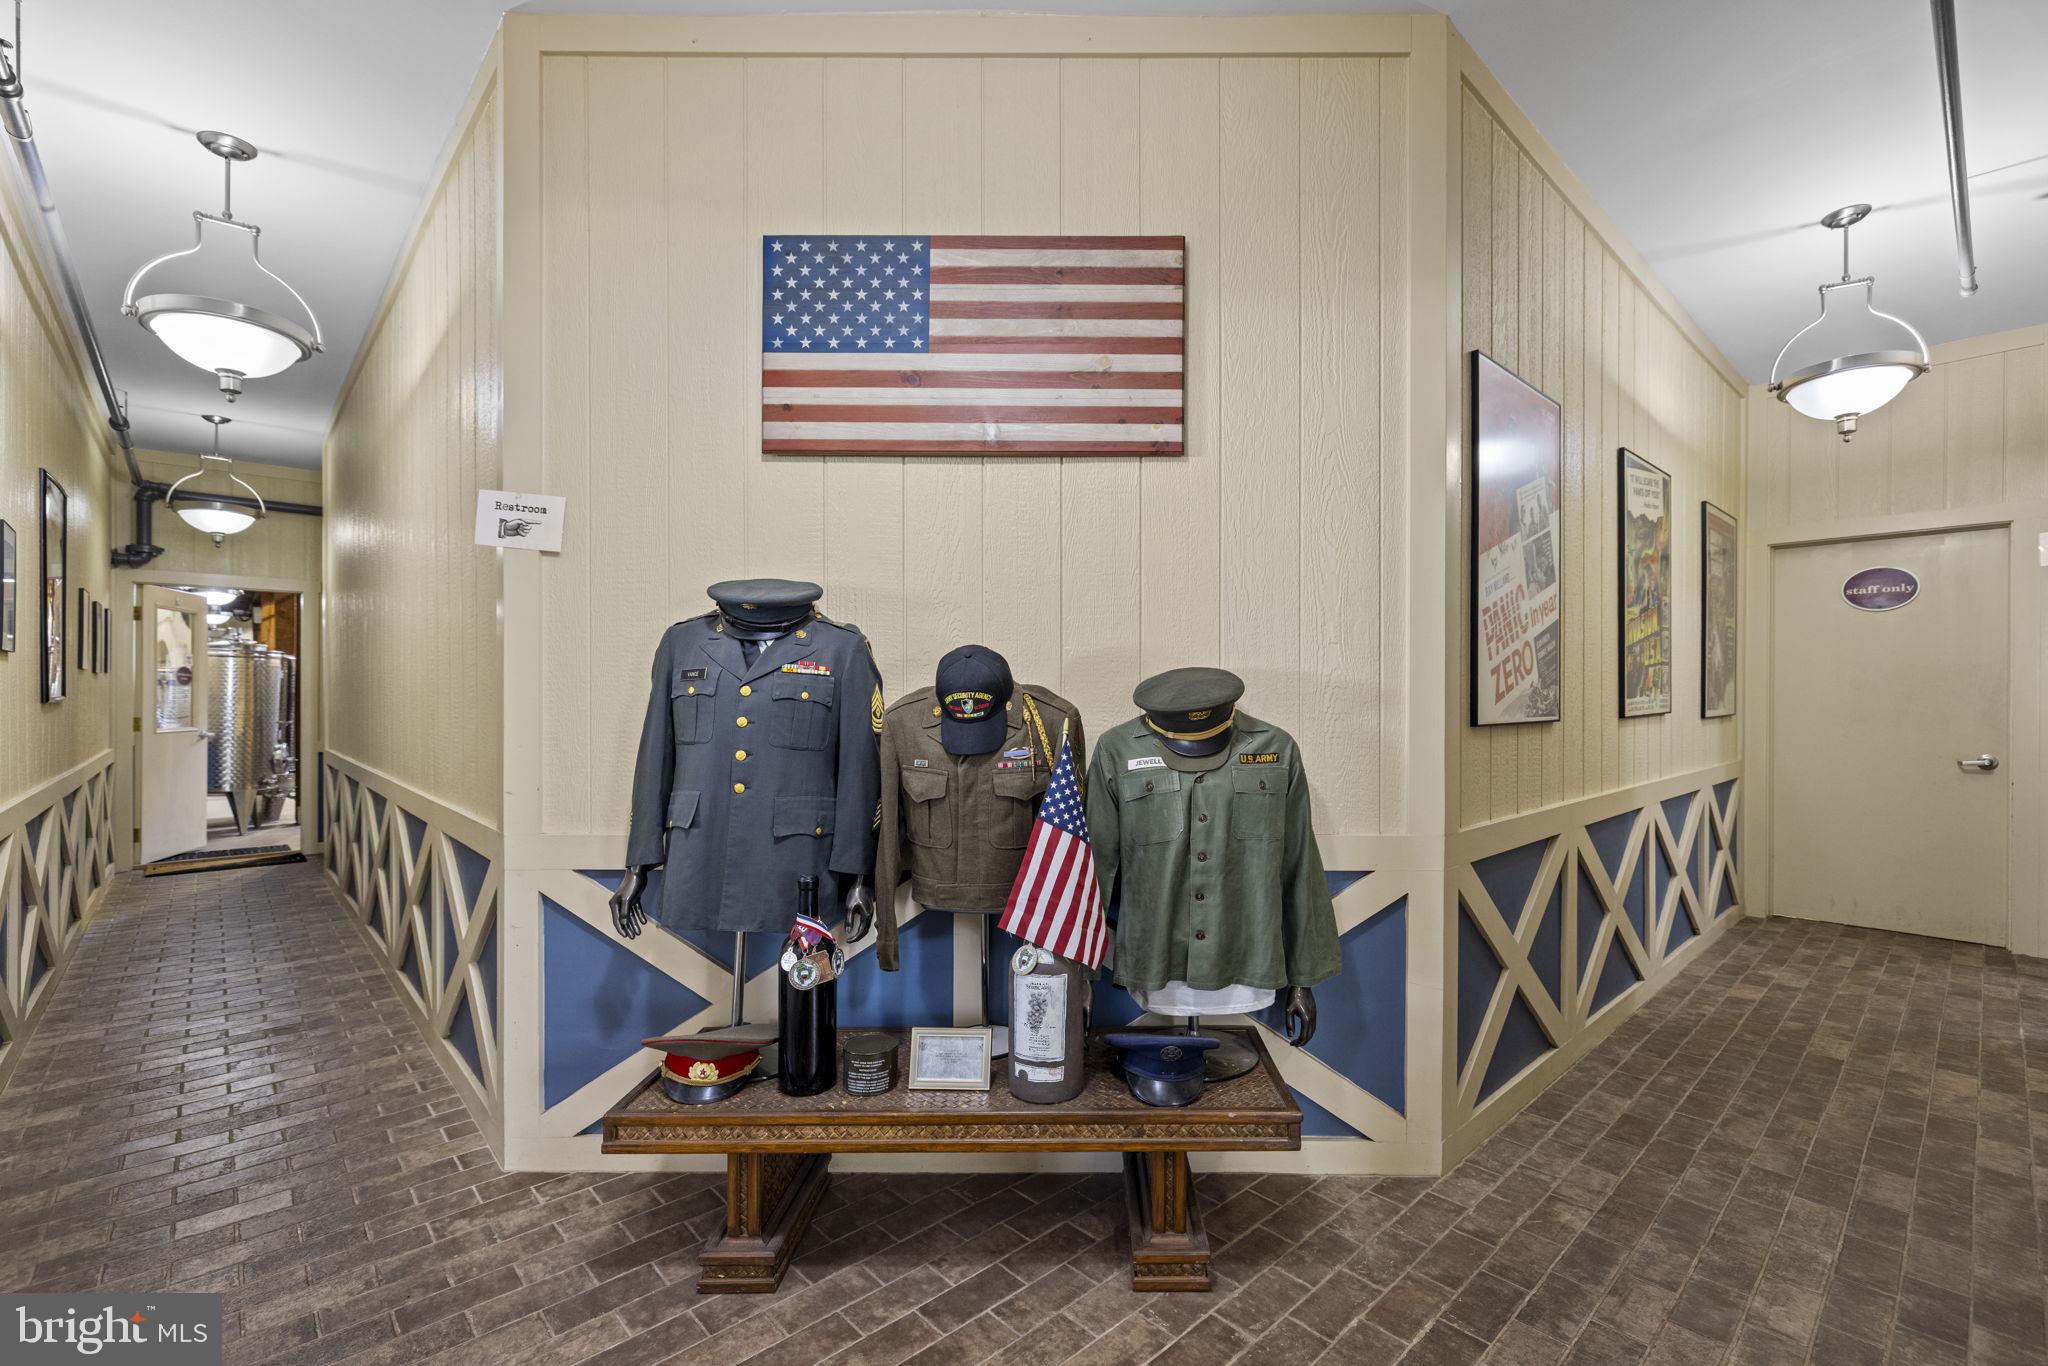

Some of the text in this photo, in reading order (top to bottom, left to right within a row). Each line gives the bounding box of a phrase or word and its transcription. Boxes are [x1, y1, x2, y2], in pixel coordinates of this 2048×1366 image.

[494, 501, 548, 515] Restroom
[1845, 583, 1914, 595] staff only
[1481, 583, 1529, 662] PANIC
[1530, 606, 1540, 628] in
[1539, 592, 1557, 626] year
[1490, 640, 1534, 706] ZERO
[974, 691, 994, 702] AGENCY
[1135, 757, 1162, 767] JEWELL
[1255, 753, 1279, 763] ARMY
